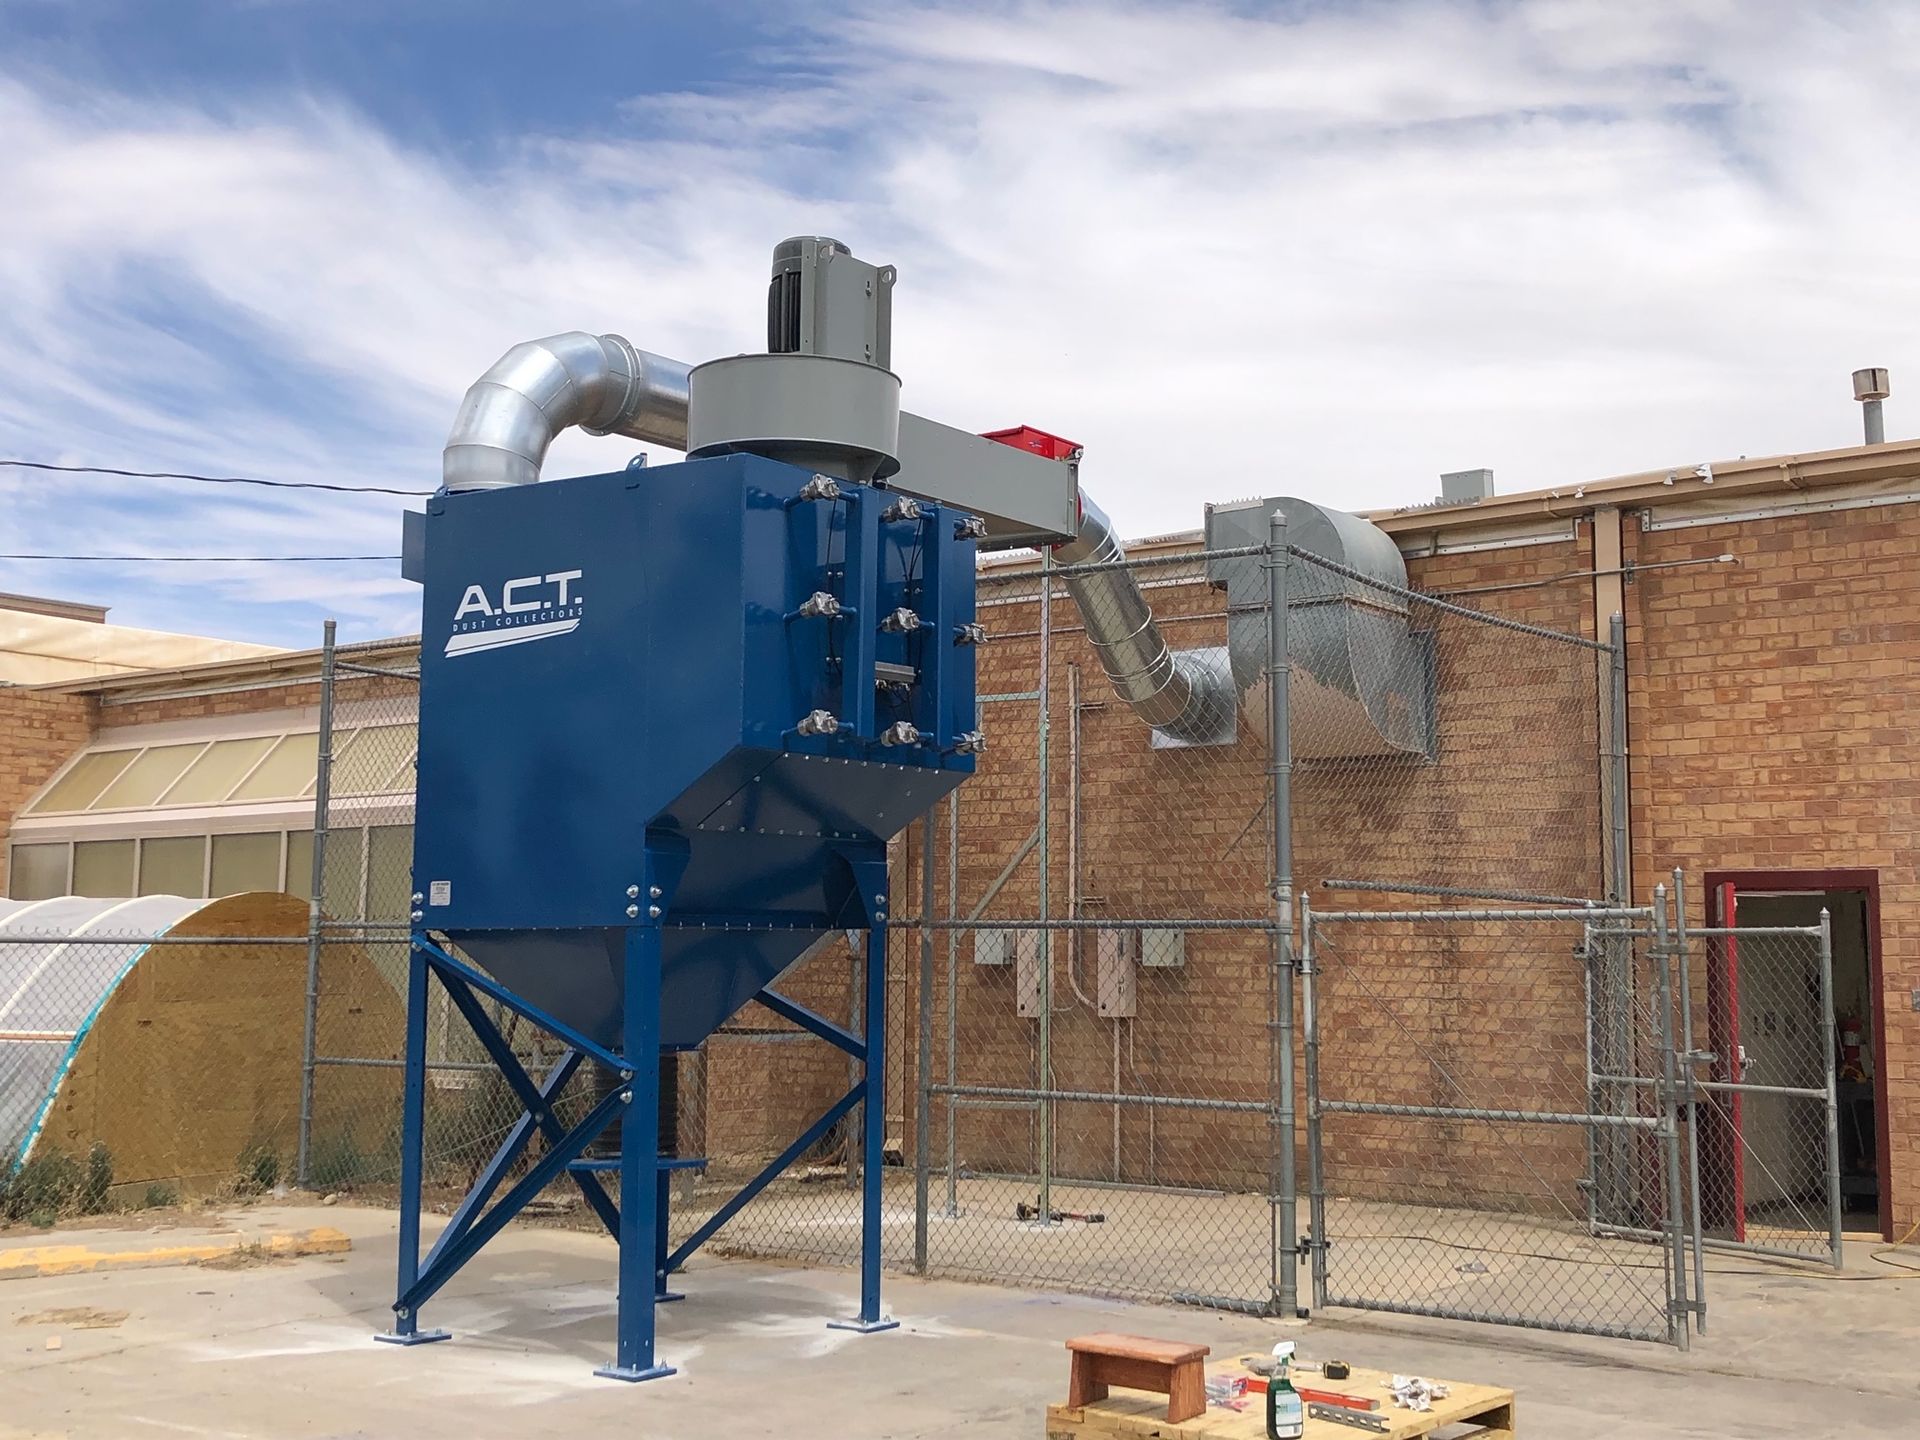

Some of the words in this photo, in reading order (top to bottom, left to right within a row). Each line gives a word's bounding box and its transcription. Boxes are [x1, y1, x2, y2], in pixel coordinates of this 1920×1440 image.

[454, 569, 583, 620] A.C.T.
[453, 620, 485, 632] DUST
[496, 607, 583, 626] COLLECTORS
